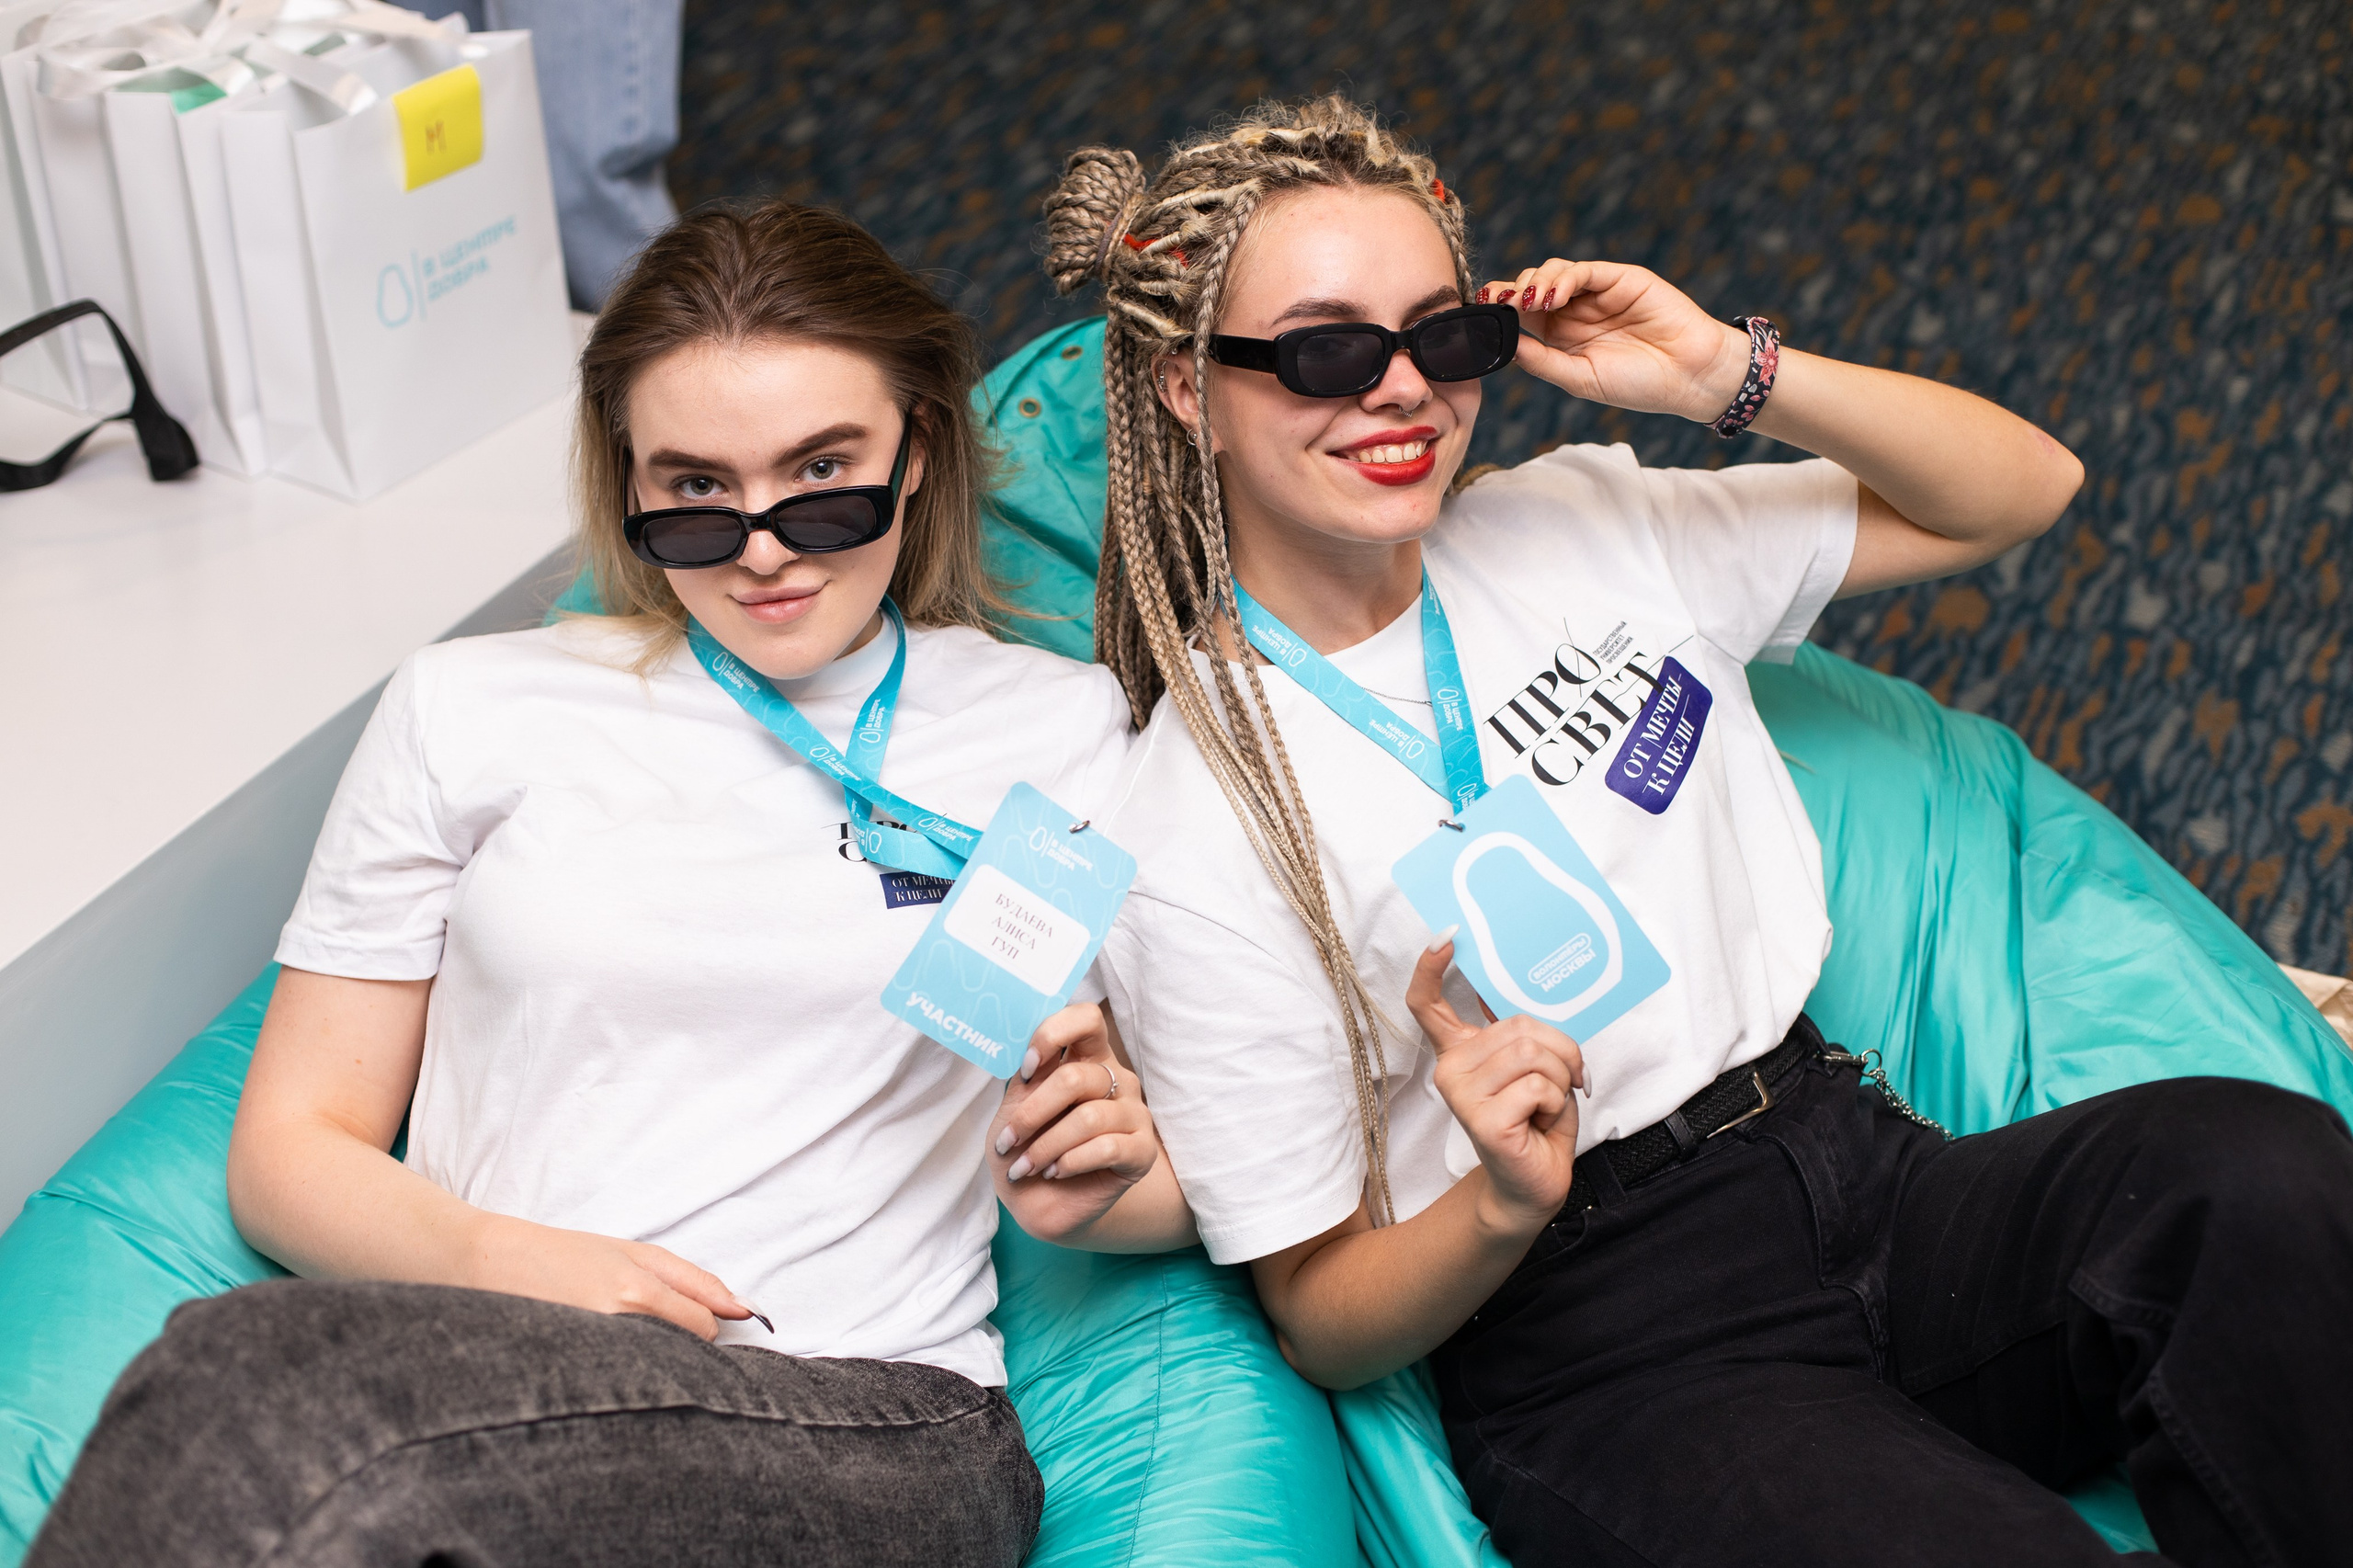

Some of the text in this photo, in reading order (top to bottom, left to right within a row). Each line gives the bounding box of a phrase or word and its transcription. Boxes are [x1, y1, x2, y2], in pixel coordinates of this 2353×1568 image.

[426, 256, 490, 301] ДОБРА
[1268, 627, 1291, 650] ДОБРА
[1592, 620, 1627, 655] ГОСУДАРСТВЕННЫЙ
[1599, 634, 1625, 660] УНИВЕРСИТЕТ
[1606, 636, 1633, 664] ПРОСВЕЩЕНИЯ
[723, 670, 744, 689] ДОБРА
[1483, 642, 1601, 759] ПРО
[873, 706, 885, 728] ДОБРА
[1442, 703, 1453, 724] ДОБРА
[1531, 652, 1665, 786] СВЕТ
[1385, 721, 1410, 742] ДОБРА
[1623, 676, 1682, 778] ОТ МЕЧТЫ
[823, 759, 846, 776] ДОБРА
[1644, 716, 1696, 795] К ЦЕЛИ
[933, 827, 956, 841] ДОБРА
[1051, 838, 1059, 847] В
[1046, 847, 1075, 871] ДОБРА
[892, 877, 908, 888] ОТ
[895, 889, 942, 902] К ЦЕЛИ
[995, 893, 1053, 938] БУДАЕВА
[992, 915, 1036, 949] АЛИСА
[991, 936, 1019, 960] ГУП
[1540, 948, 1597, 993] МОСКВЫ
[905, 991, 1005, 1059] УЧАСТНИК
